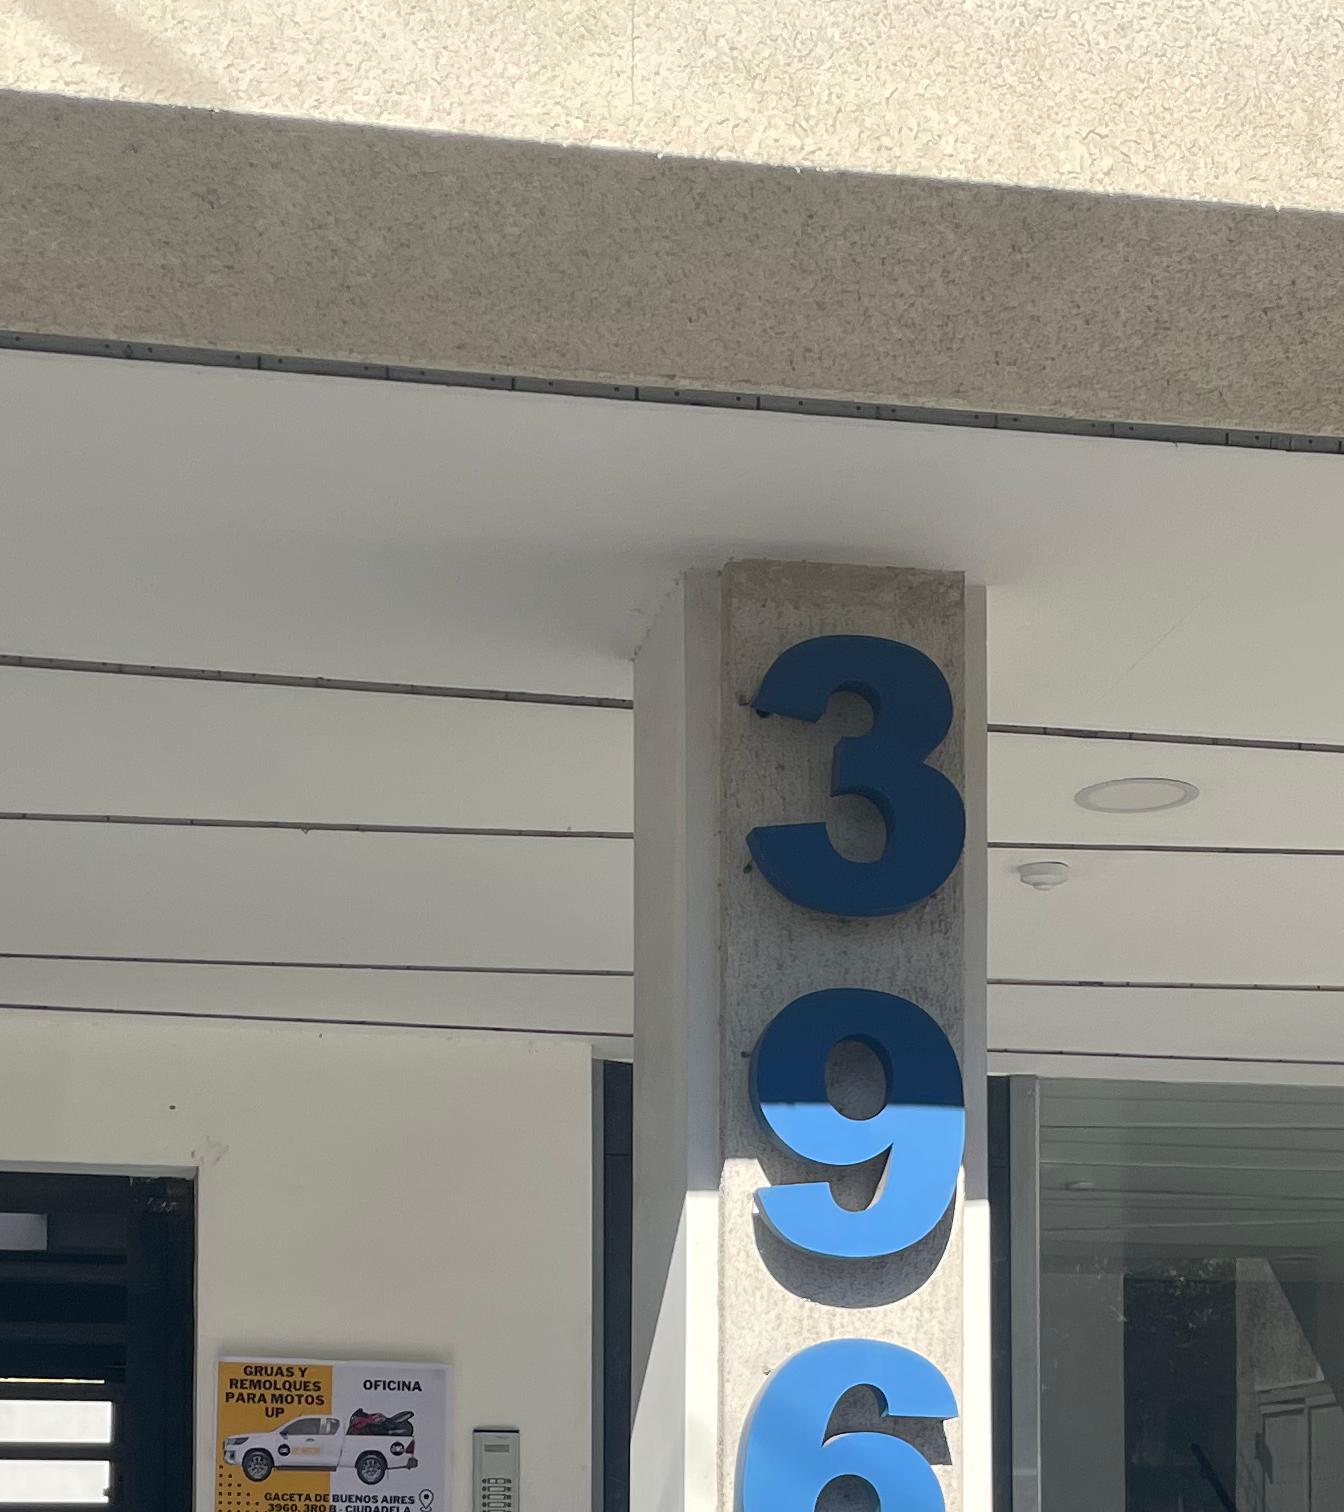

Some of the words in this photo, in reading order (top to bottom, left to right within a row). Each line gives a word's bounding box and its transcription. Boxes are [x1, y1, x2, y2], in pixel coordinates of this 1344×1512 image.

[243, 1365, 294, 1377] GRUAS
[298, 1367, 308, 1378] Y
[229, 1378, 322, 1392] REMOLQUES
[363, 1379, 423, 1392] OFICINA
[225, 1392, 267, 1404] PARA
[271, 1393, 325, 1406] MOTOS
[265, 1406, 285, 1418] UP
[264, 1492, 312, 1502] GACETA
[315, 1493, 330, 1503] DE
[332, 1494, 379, 1504] BUENOS
[381, 1495, 416, 1505] AIRES
[303, 1504, 327, 1512] 3RO
[329, 1504, 337, 1512] B
